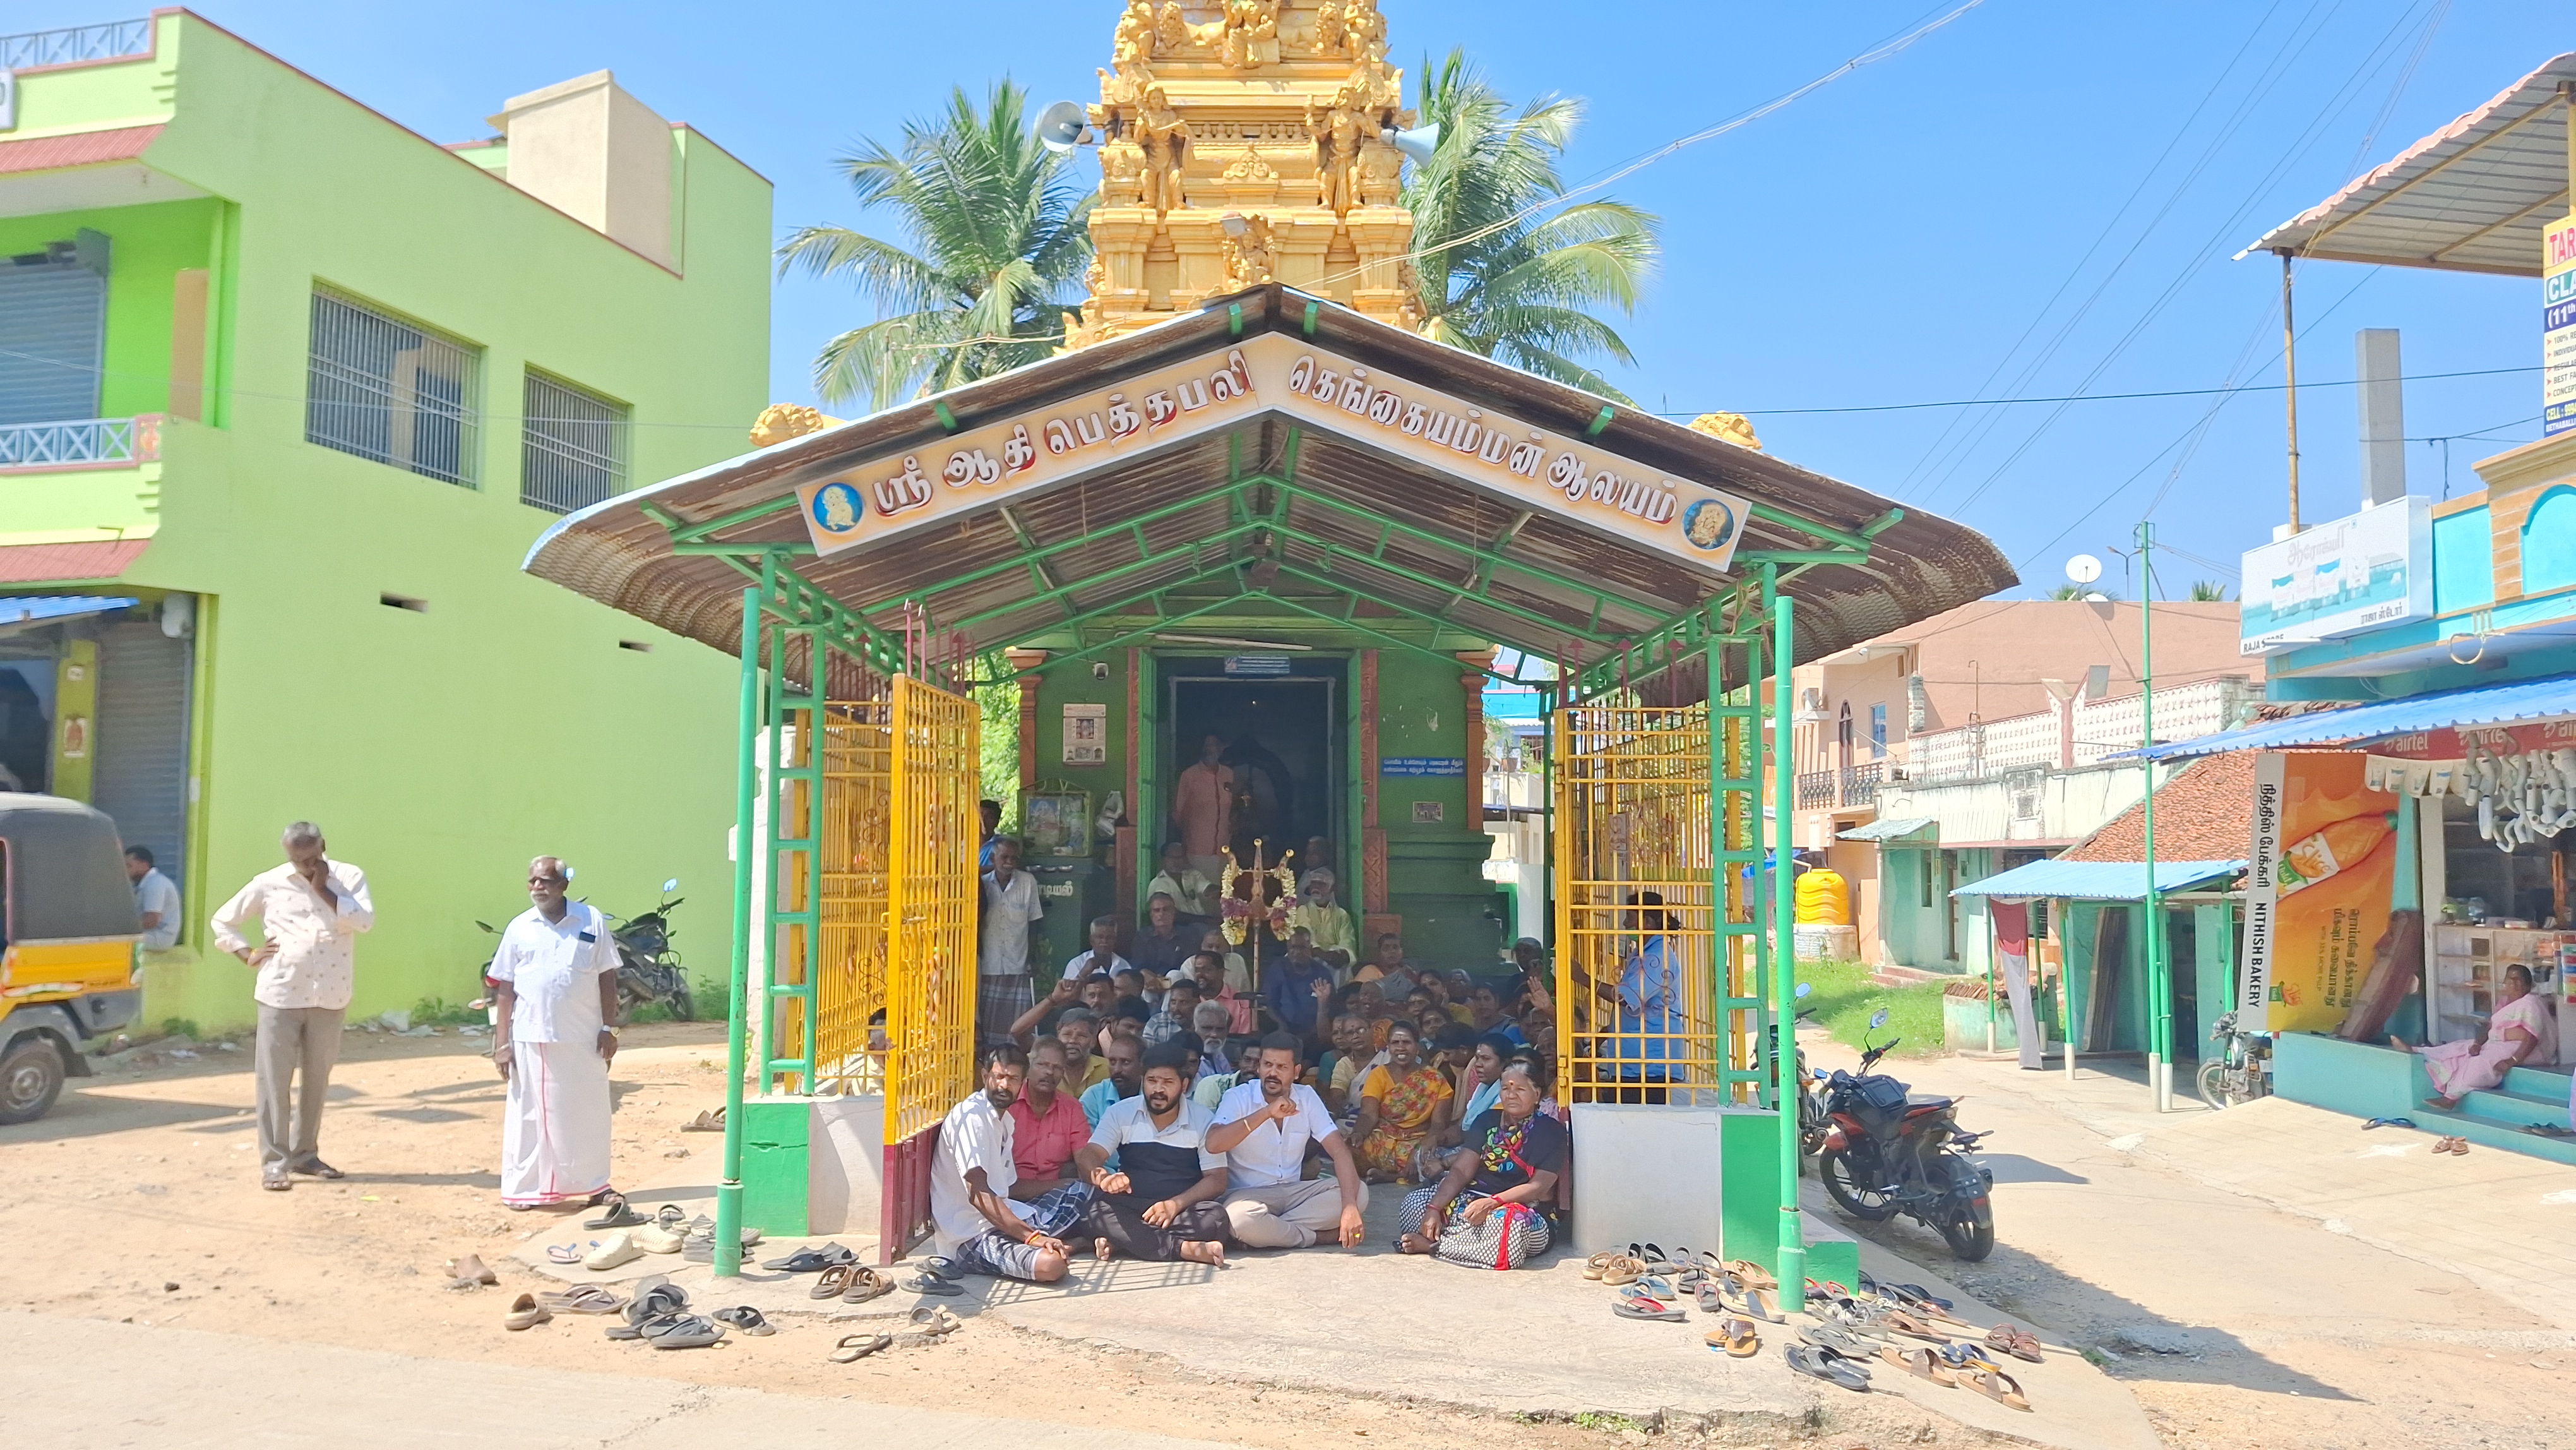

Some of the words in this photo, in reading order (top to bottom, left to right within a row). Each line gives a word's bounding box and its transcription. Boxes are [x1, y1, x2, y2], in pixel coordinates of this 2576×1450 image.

[2554, 373, 2568, 384] BEST
[943, 424, 1036, 488] ஆதி
[1044, 349, 1255, 454] பெத்தபலி
[1289, 354, 1547, 479] கெங்கையம்மன்
[1547, 451, 1678, 525] ஆலயம்
[2244, 640, 2260, 653] RAJA
[2396, 732, 2428, 752] airtel
[2258, 784, 2276, 833] நித்திஸ்
[2257, 837, 2274, 887] பேக்கரி
[2252, 902, 2267, 954] NITHISH
[2248, 958, 2263, 1007] BAKERY
